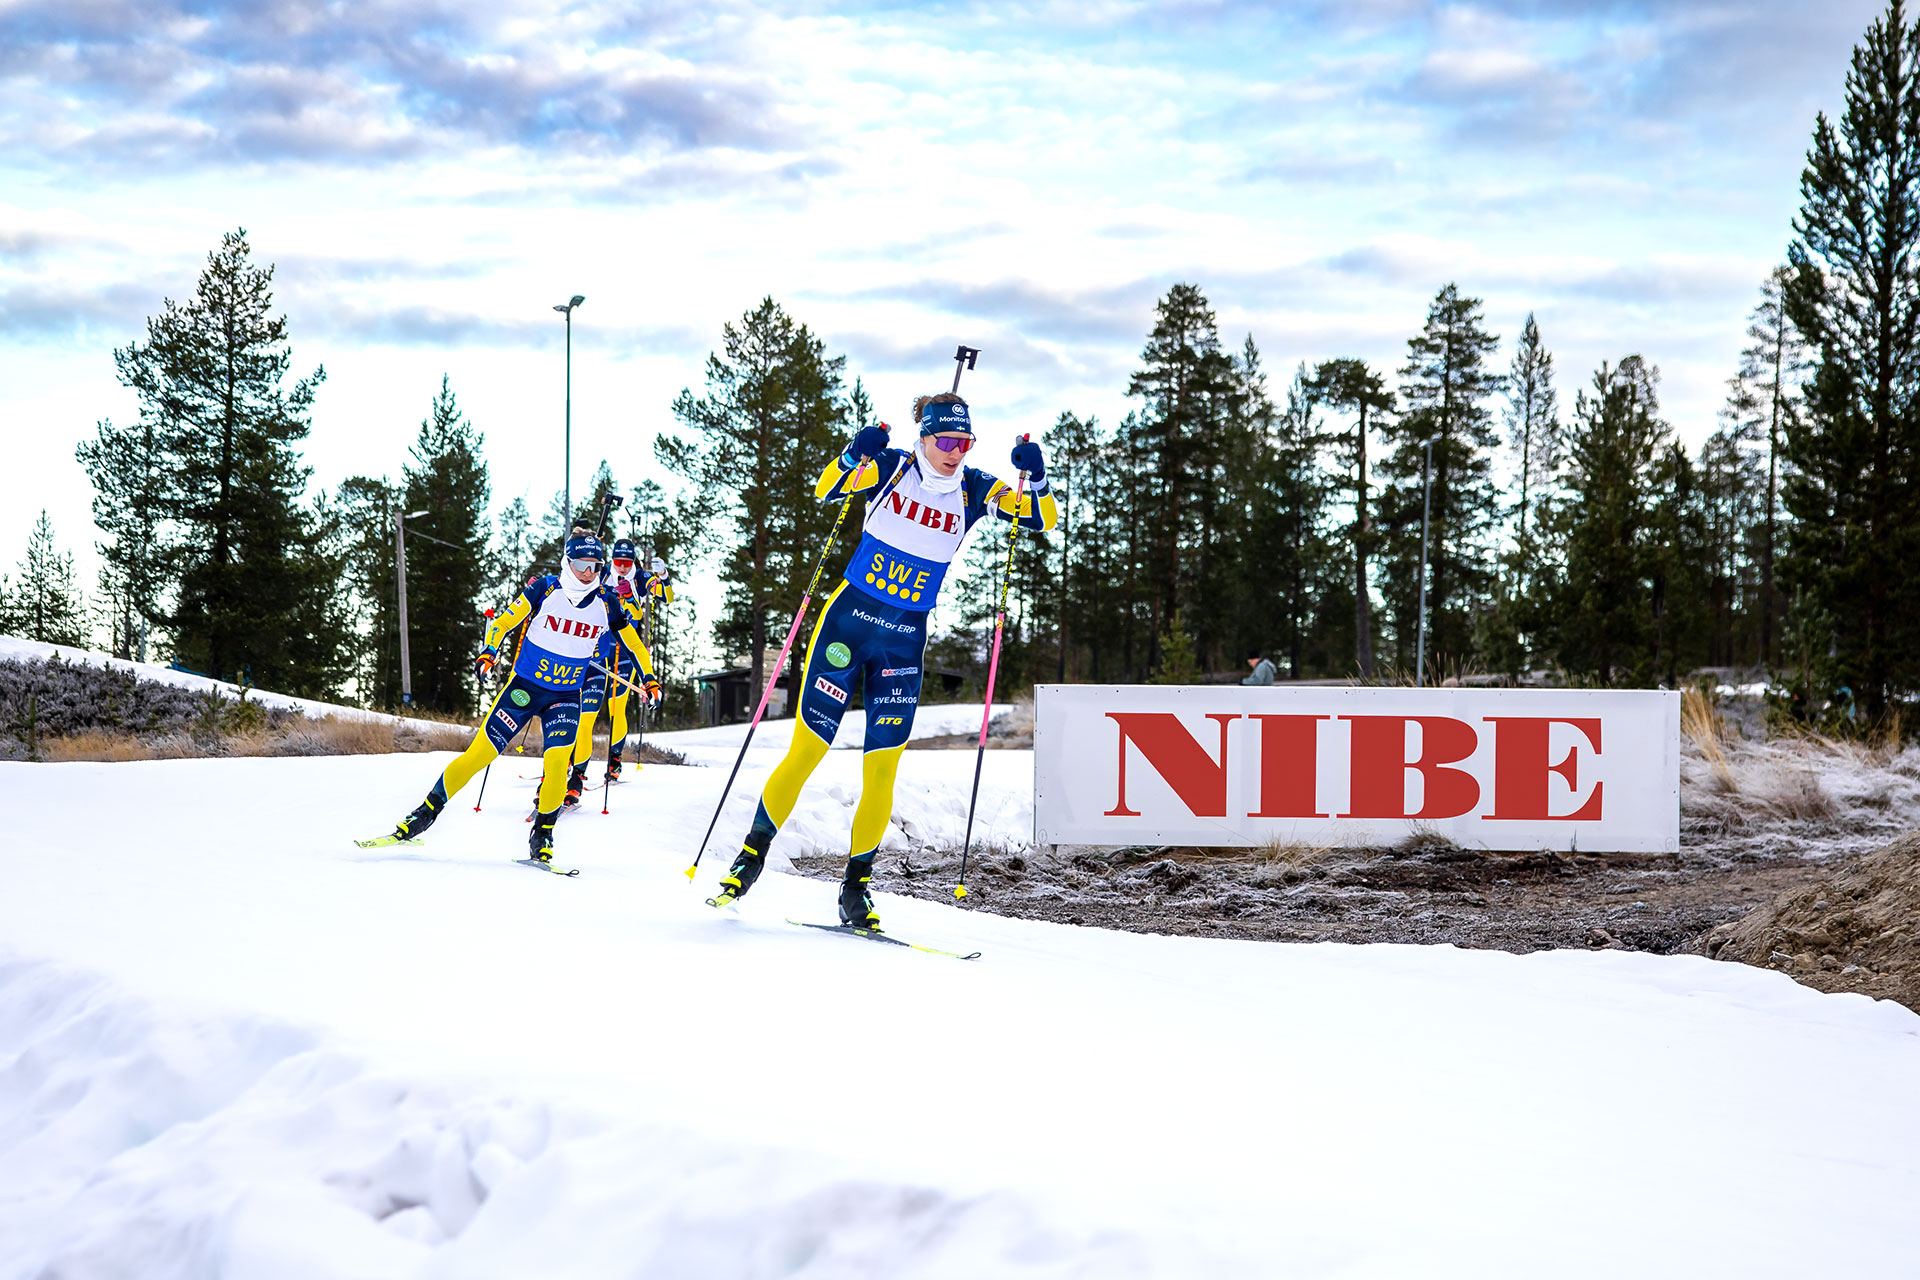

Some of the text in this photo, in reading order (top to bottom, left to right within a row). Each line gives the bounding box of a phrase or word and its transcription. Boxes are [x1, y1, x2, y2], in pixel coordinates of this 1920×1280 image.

[883, 490, 960, 535] NIBE
[871, 553, 930, 590] SWE
[851, 608, 916, 634] Monitor ERP
[828, 645, 849, 663] dina
[538, 658, 584, 678] SWE
[817, 680, 846, 703] NIBE
[875, 717, 903, 726] ATG
[1104, 712, 1604, 821] NIBE
